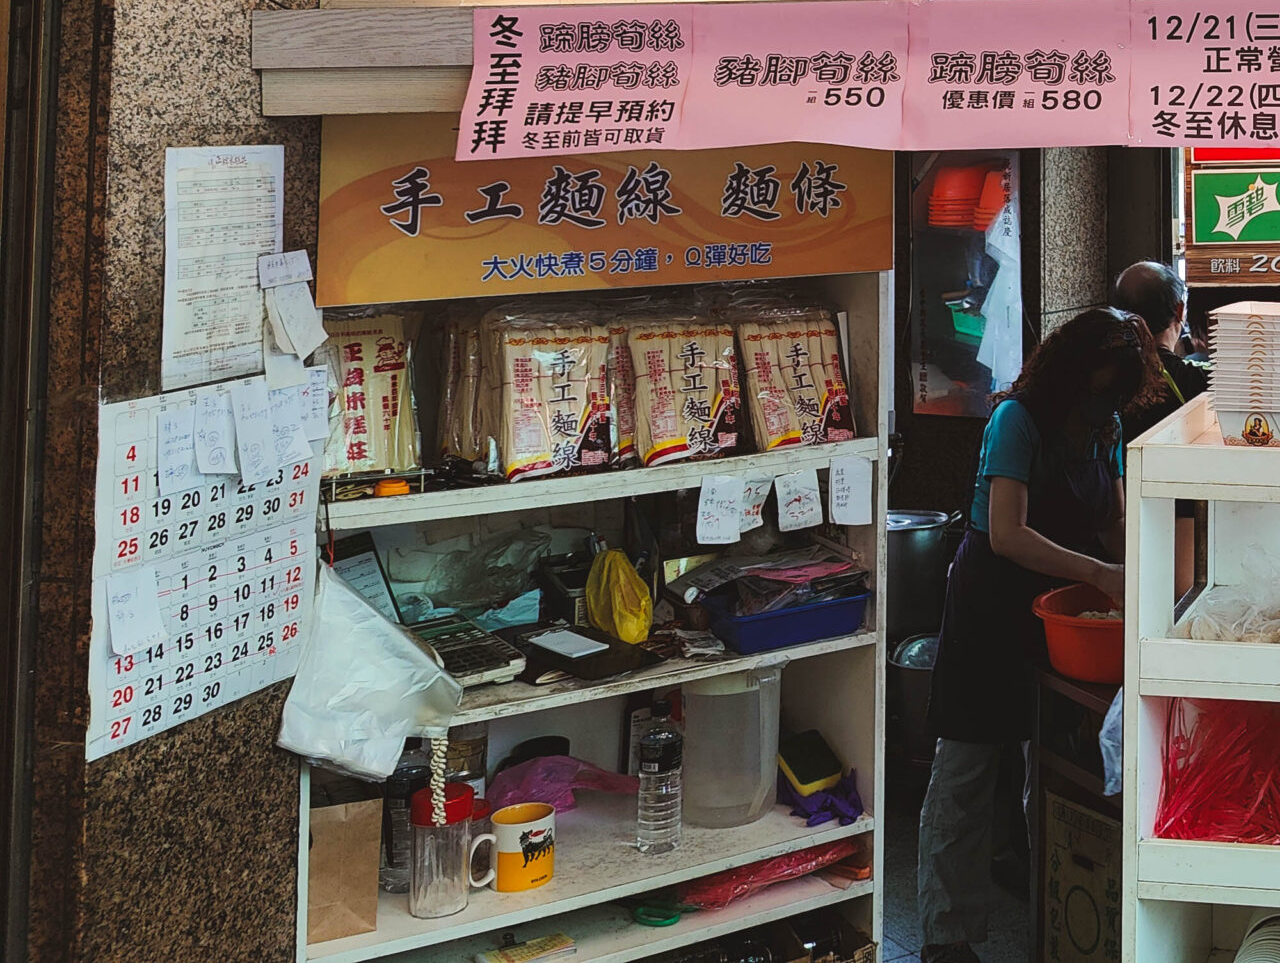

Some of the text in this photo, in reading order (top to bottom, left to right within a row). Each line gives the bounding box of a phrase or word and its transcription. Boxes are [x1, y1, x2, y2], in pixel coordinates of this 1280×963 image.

[538, 19, 685, 54] 蹄膀筍絲
[470, 14, 524, 154] 冬至拜拜
[534, 60, 681, 92] 豬腳筍絲
[713, 50, 901, 88] 豬腳筍絲
[928, 49, 1117, 86] 蹄膀筍絲
[523, 100, 676, 127] 請提早預約
[823, 86, 886, 108] 550
[941, 90, 1016, 111] 優惠價
[1041, 89, 1103, 111] 580
[521, 127, 667, 151] 冬至前皆可取貨
[380, 160, 848, 237] 手工麵線 麵條
[1226, 185, 1268, 228] 雪碧
[1210, 258, 1241, 274] 飲料
[550, 349, 582, 471] 手工麵線
[677, 341, 719, 453] 手工麵線
[785, 342, 825, 446] 手工麵線
[125, 445, 137, 463] 4
[119, 505, 140, 526] 18
[152, 498, 172, 518] 19
[181, 490, 201, 511] 20
[210, 483, 226, 502] 21
[292, 462, 309, 480] 24
[121, 475, 140, 495] 11
[117, 489, 306, 558] 25 26 27 28 29 30 31
[181, 540, 298, 590] 1 2 3 4 5
